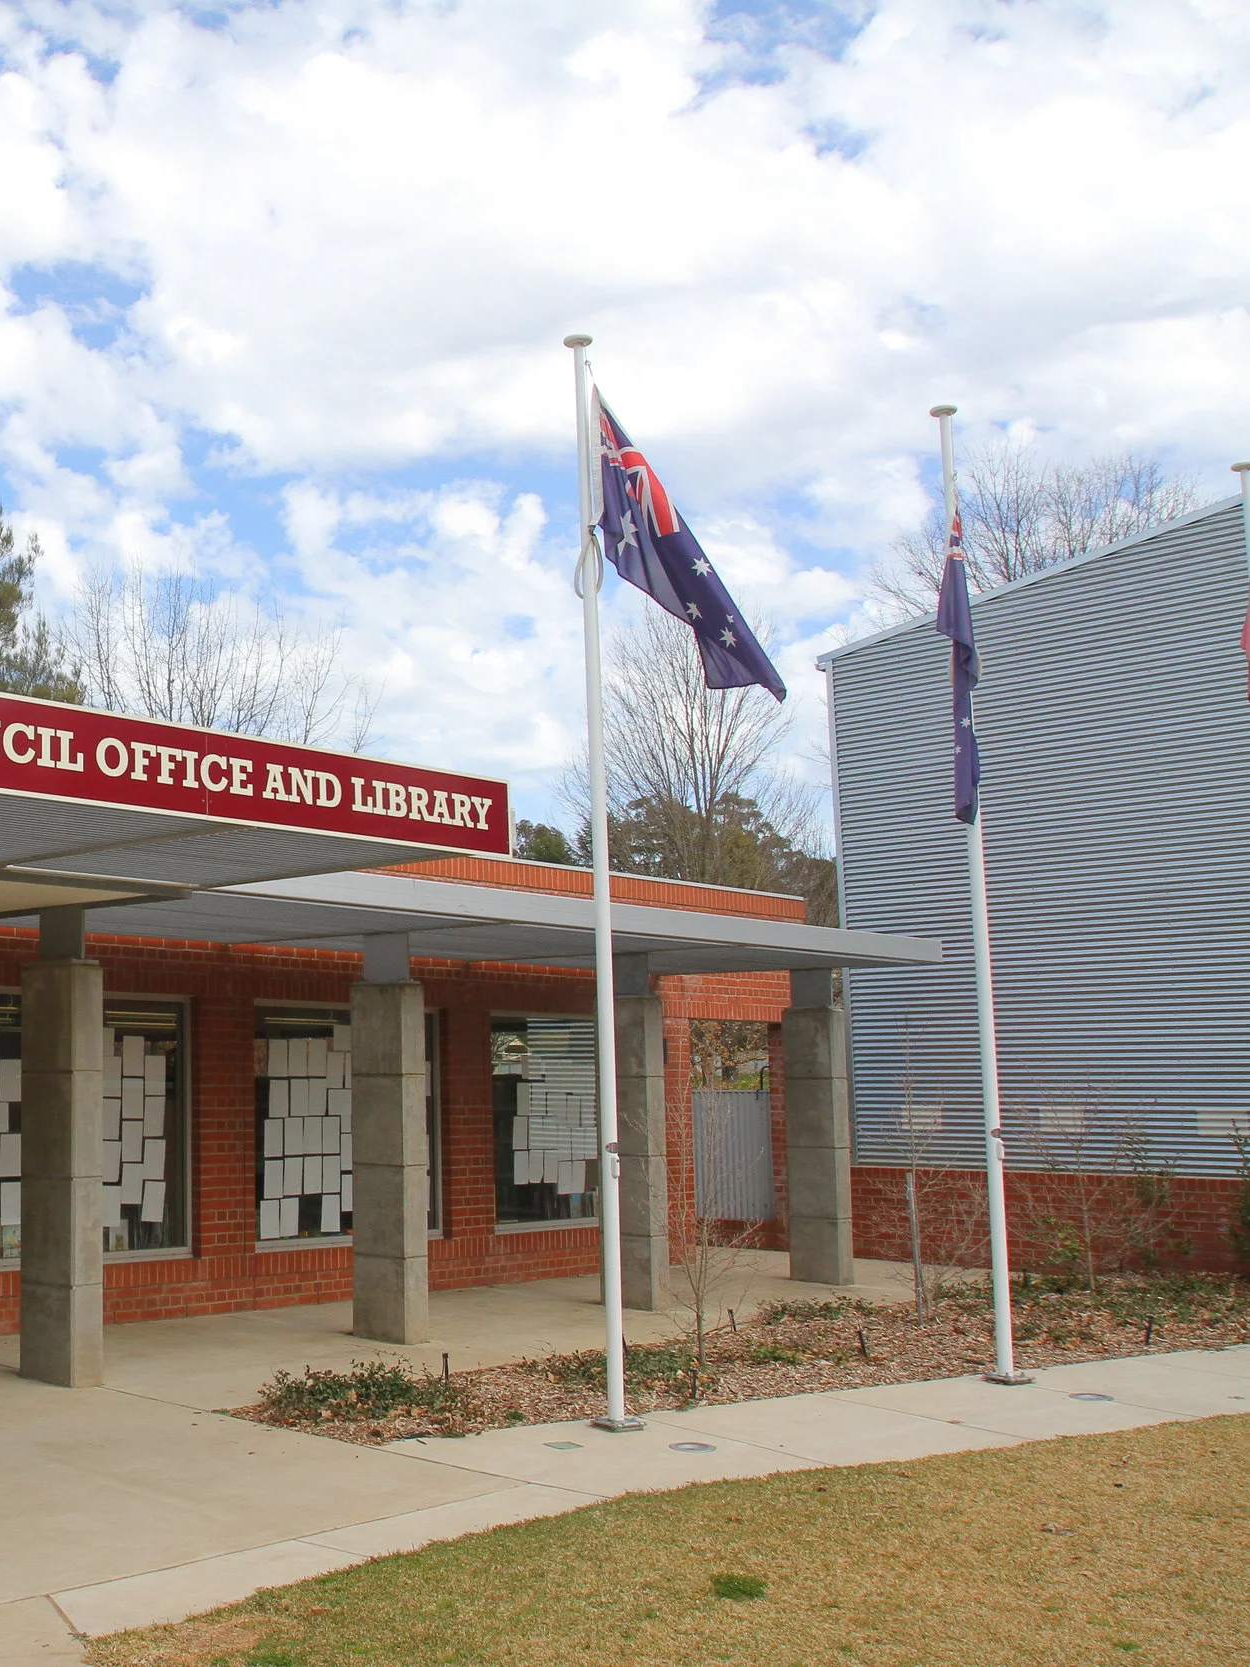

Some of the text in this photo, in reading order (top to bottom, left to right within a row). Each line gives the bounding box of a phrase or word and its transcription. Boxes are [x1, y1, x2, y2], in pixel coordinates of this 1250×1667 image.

[95, 737, 254, 796] OFFICE
[263, 763, 343, 809] AND
[350, 777, 493, 831] LIBRARY
